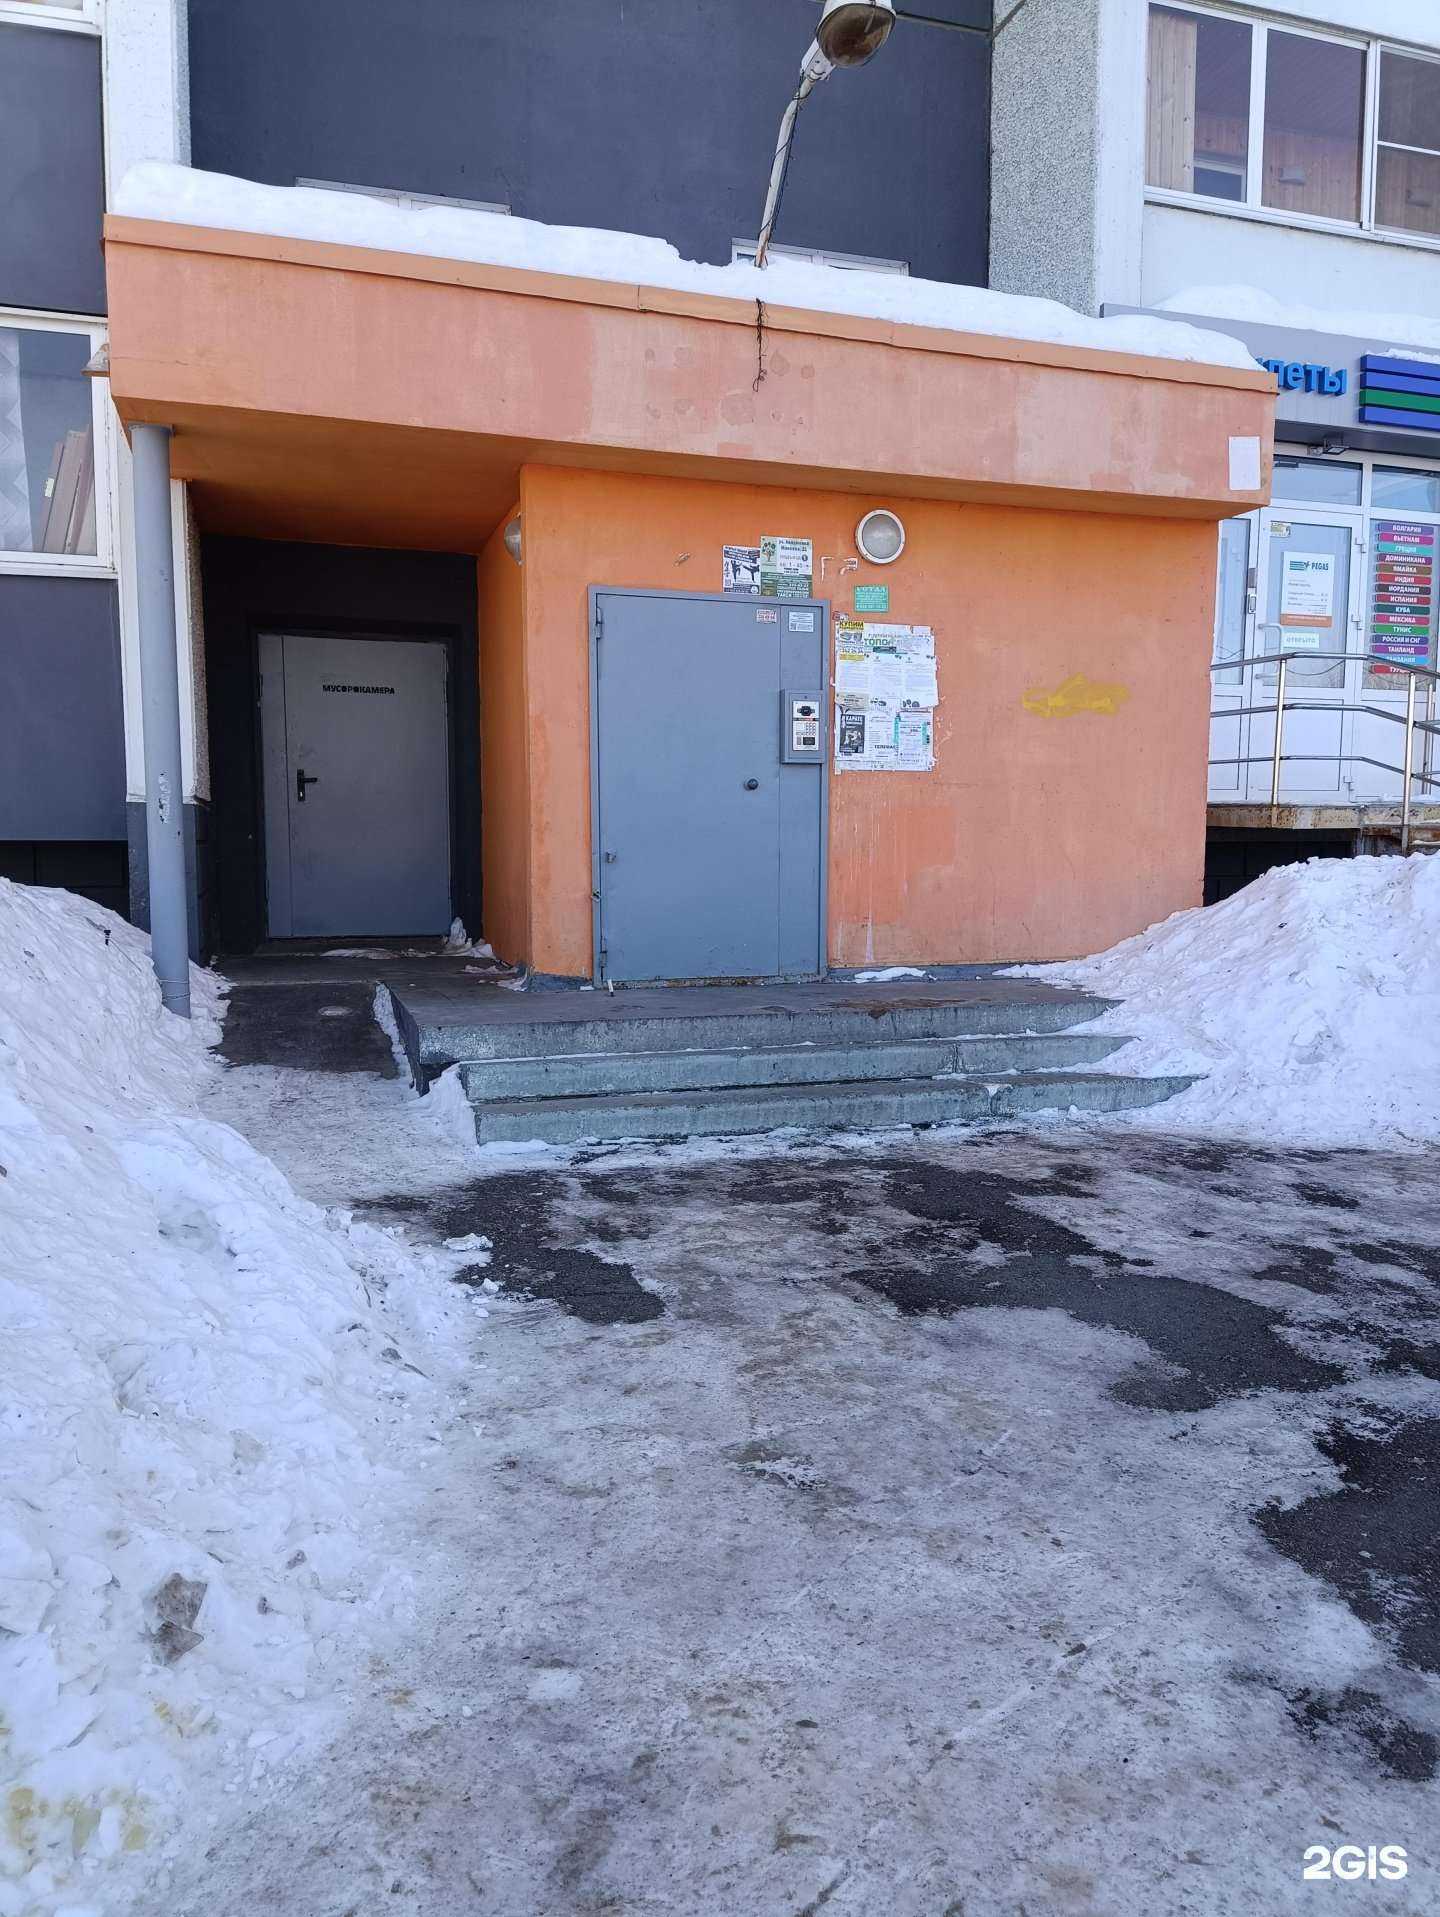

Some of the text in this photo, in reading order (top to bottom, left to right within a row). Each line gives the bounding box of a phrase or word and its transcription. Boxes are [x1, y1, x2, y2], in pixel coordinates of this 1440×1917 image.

[1392, 524, 1422, 533] БОЛГАРИЯ
[1393, 534, 1420, 543] ВЬЕТНАМ
[1385, 554, 1426, 563] ДОМИНИКАНА
[1311, 562, 1329, 571] PEGAS
[1393, 565, 1417, 573] ЯМАЙКА
[1390, 595, 1418, 603] ИСПАНИЯ
[1395, 606, 1411, 614] КУБА
[1393, 626, 1412, 634] ТУНИС
[1382, 635, 1404, 643] РОССИЯ
[322, 684, 396, 695] МУСОРОКАМЕРА
